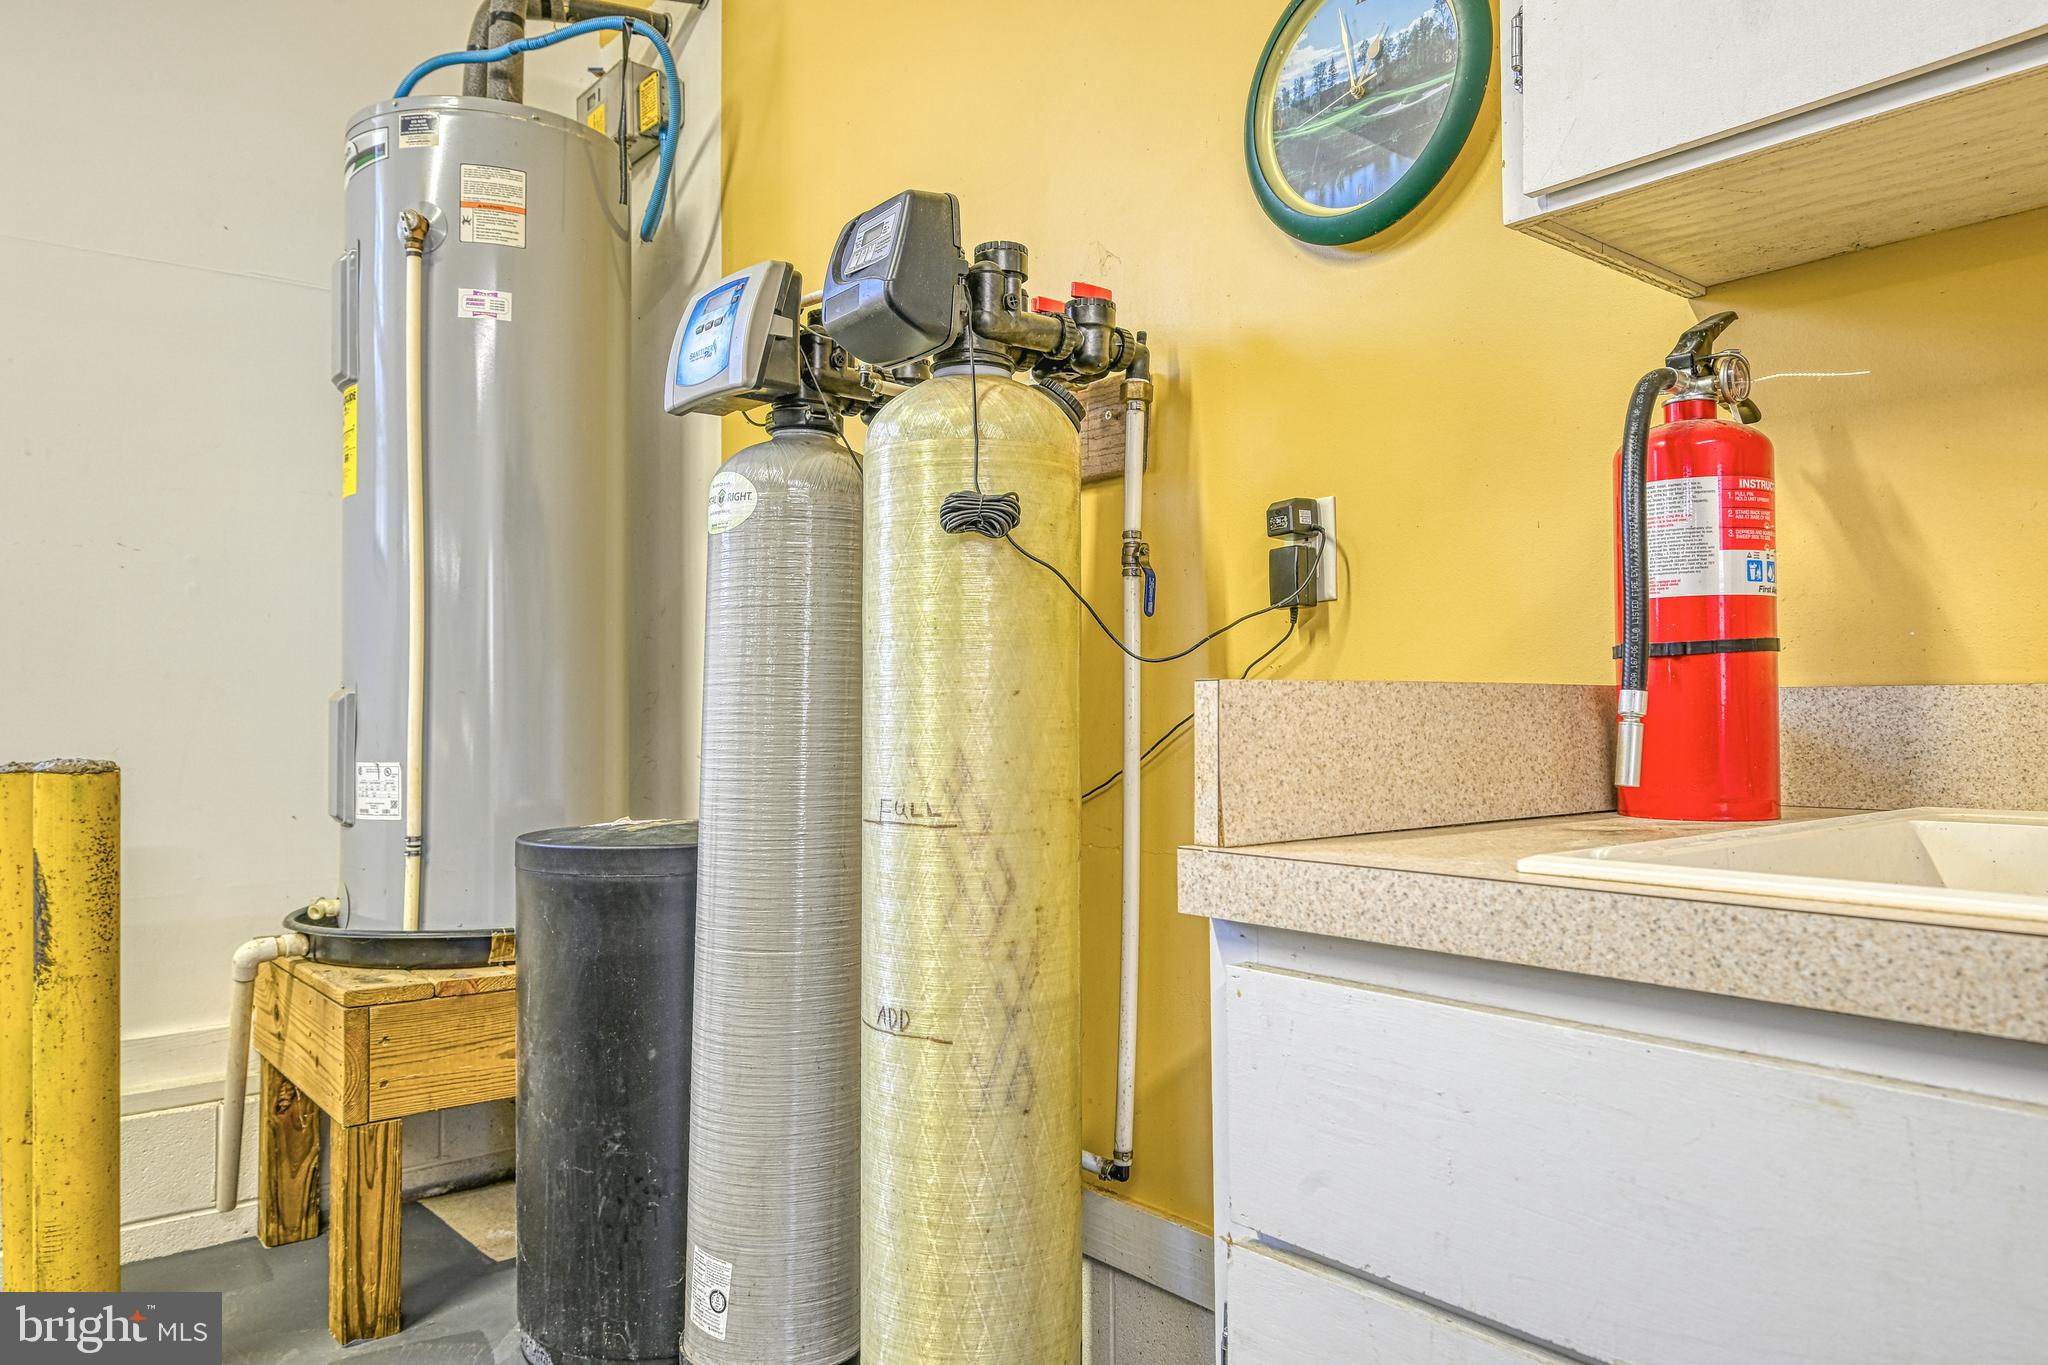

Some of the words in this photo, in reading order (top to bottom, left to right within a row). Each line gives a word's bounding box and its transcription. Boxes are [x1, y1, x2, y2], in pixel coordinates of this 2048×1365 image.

[1631, 580, 1639, 597] FIRE
[1631, 599, 1640, 625] LISTED
[879, 799, 942, 824] FULL
[877, 1005, 911, 1032] ADD
